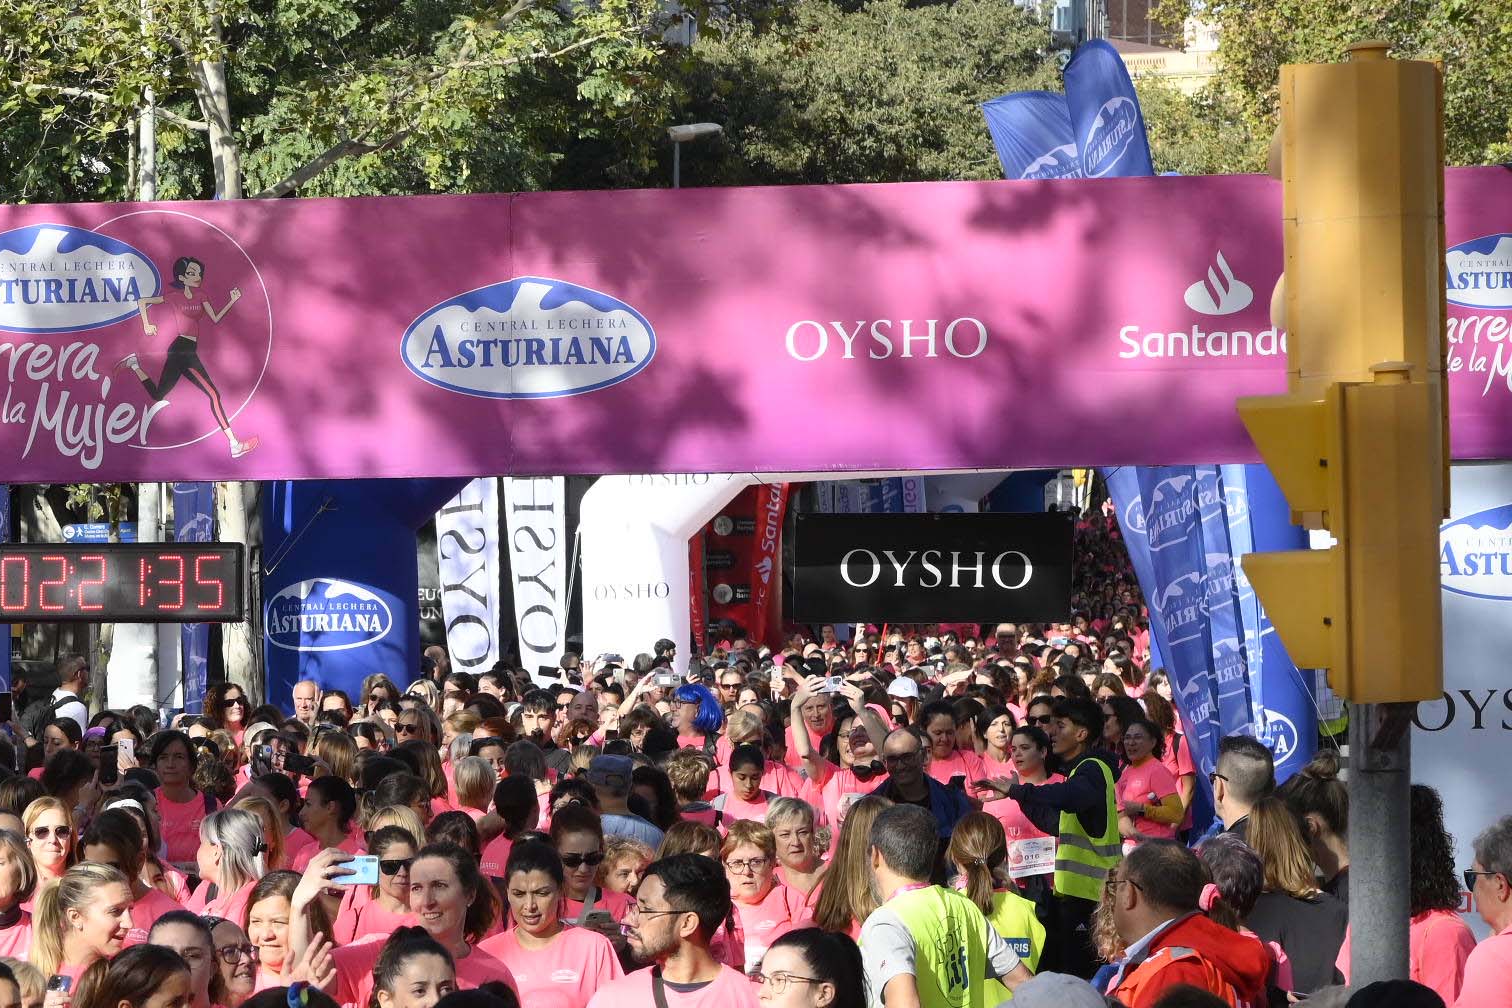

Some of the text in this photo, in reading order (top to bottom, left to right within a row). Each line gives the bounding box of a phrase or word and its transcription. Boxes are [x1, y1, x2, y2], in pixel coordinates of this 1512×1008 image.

[63, 260, 136, 272] LECHERA
[460, 317, 629, 332] CENTRAL LECHERA
[421, 324, 636, 369] ASTURIANA
[785, 317, 988, 361] OYSHO
[1469, 345, 1487, 372] la
[2, 385, 26, 424] la
[21, 376, 171, 470] Mujer
[0, 555, 222, 611] 02:21:35
[840, 548, 1033, 590] OYSHO
[594, 582, 670, 601] OYSHO
[270, 607, 383, 635] ASTURIANA
[282, 603, 378, 612] CENTRAL LECHERA
